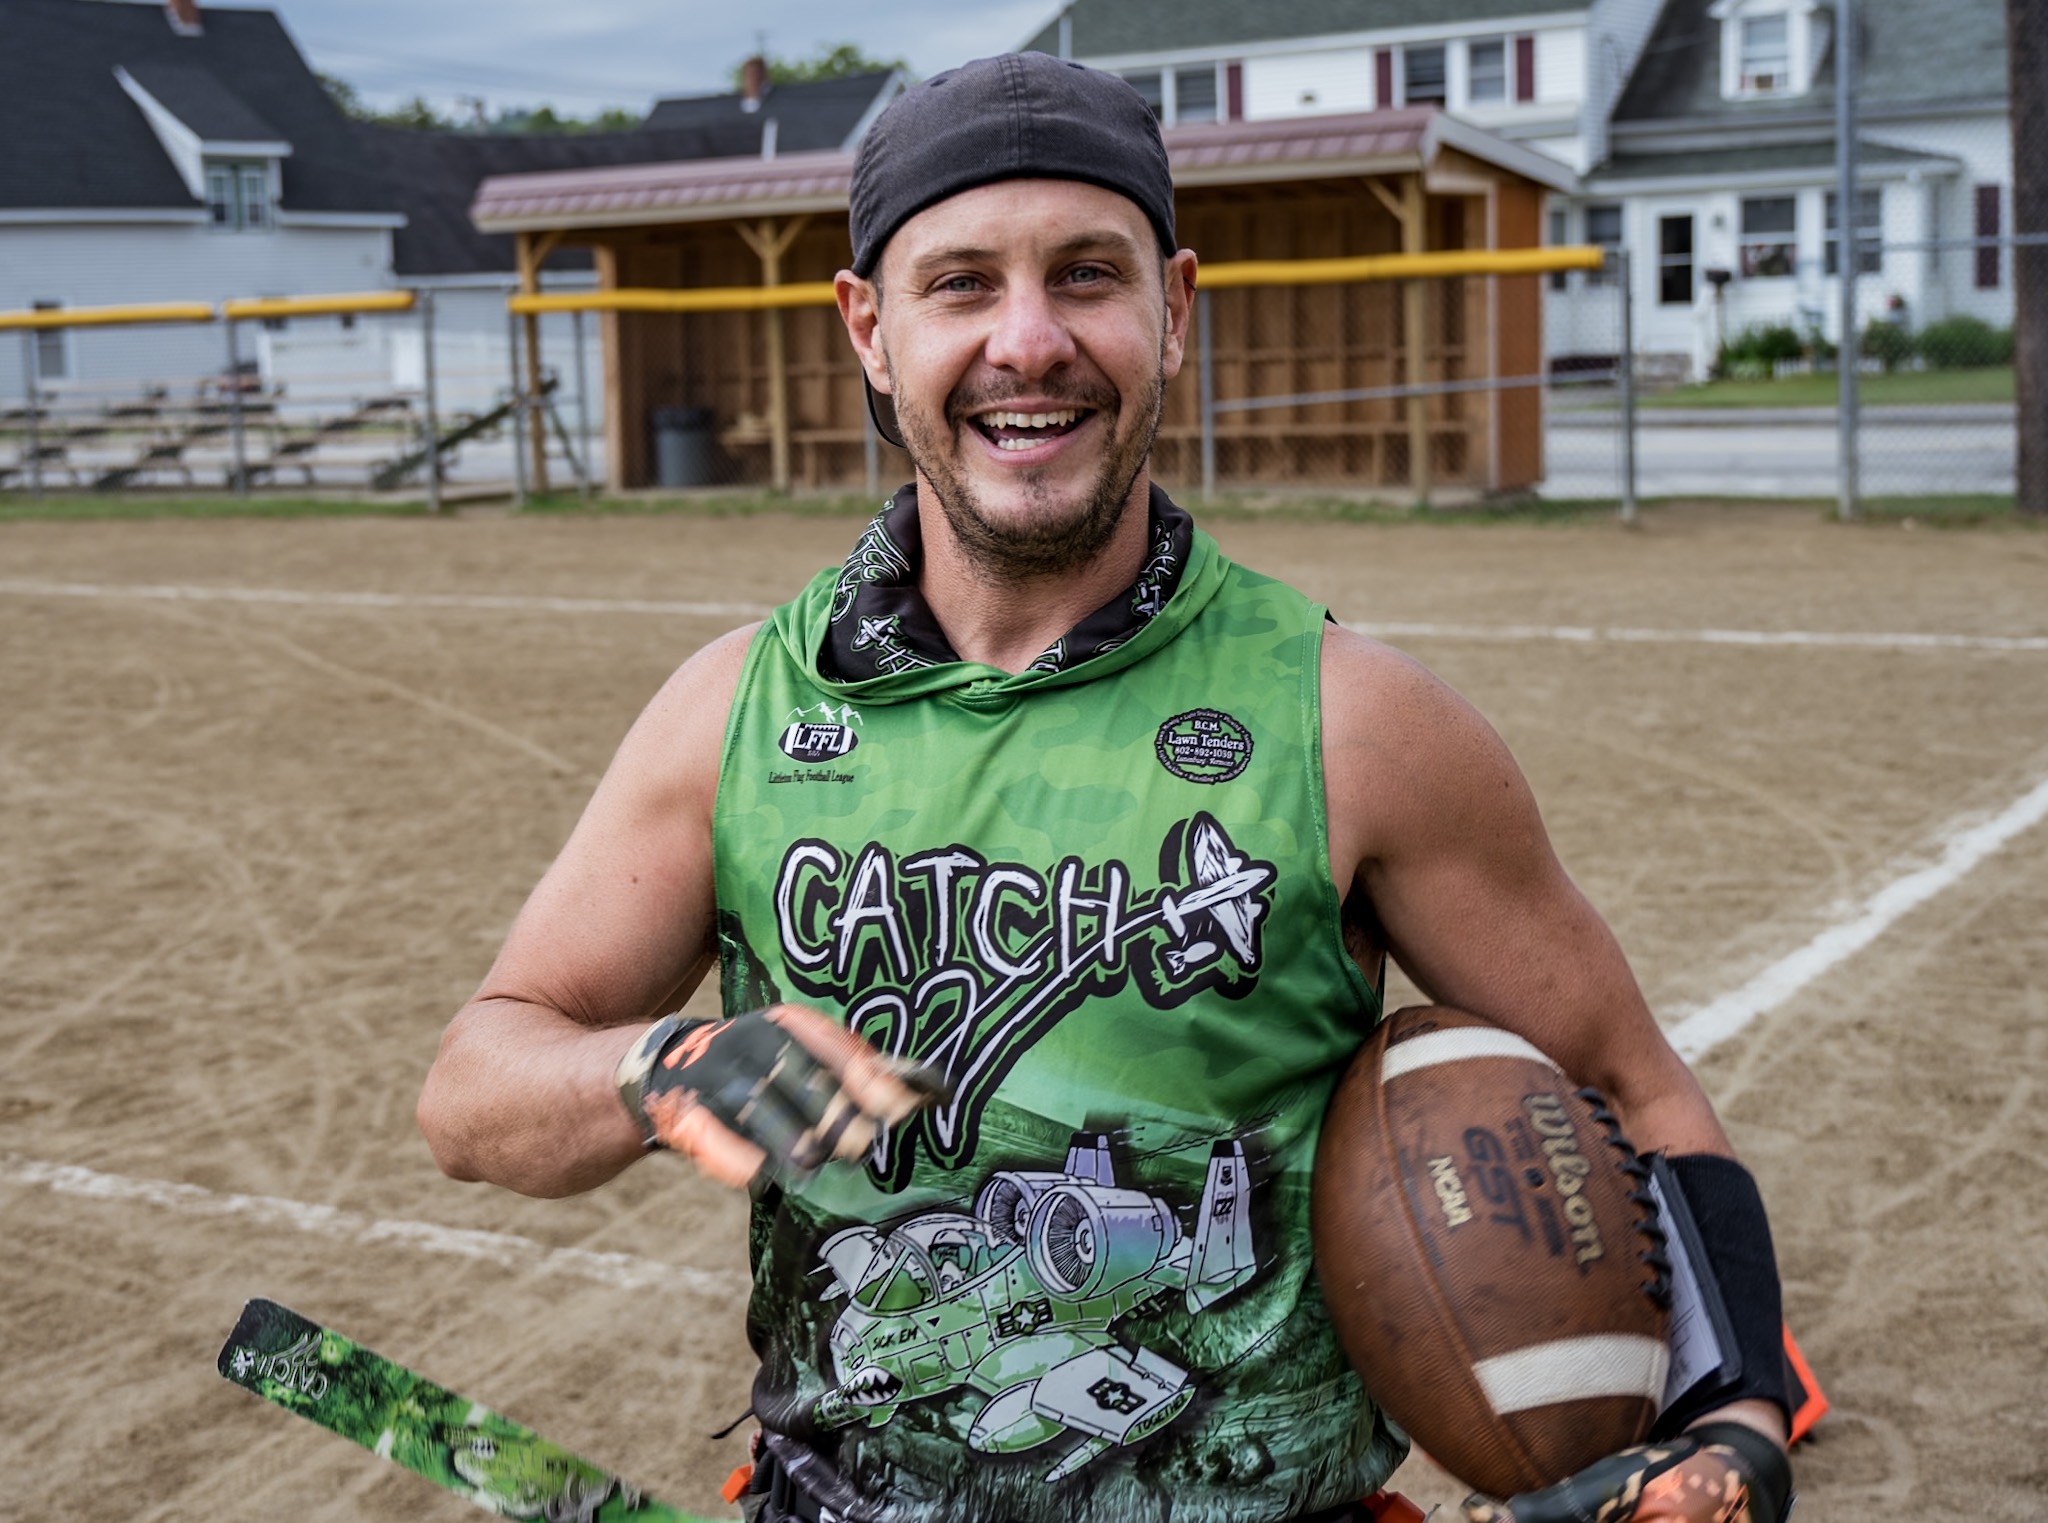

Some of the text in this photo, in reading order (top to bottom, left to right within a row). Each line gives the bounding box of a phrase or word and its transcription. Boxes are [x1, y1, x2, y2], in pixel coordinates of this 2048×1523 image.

[793, 727, 840, 752] LFFL
[1168, 731, 1198, 745] Lawn
[1200, 733, 1244, 751] Tenders
[831, 769, 855, 784] League
[777, 842, 1124, 979] CATCH
[1427, 1155, 1474, 1229] NCAA
[1463, 1126, 1533, 1243] GST
[1522, 1094, 1605, 1266] Wilson
[898, 1325, 919, 1345] EM
